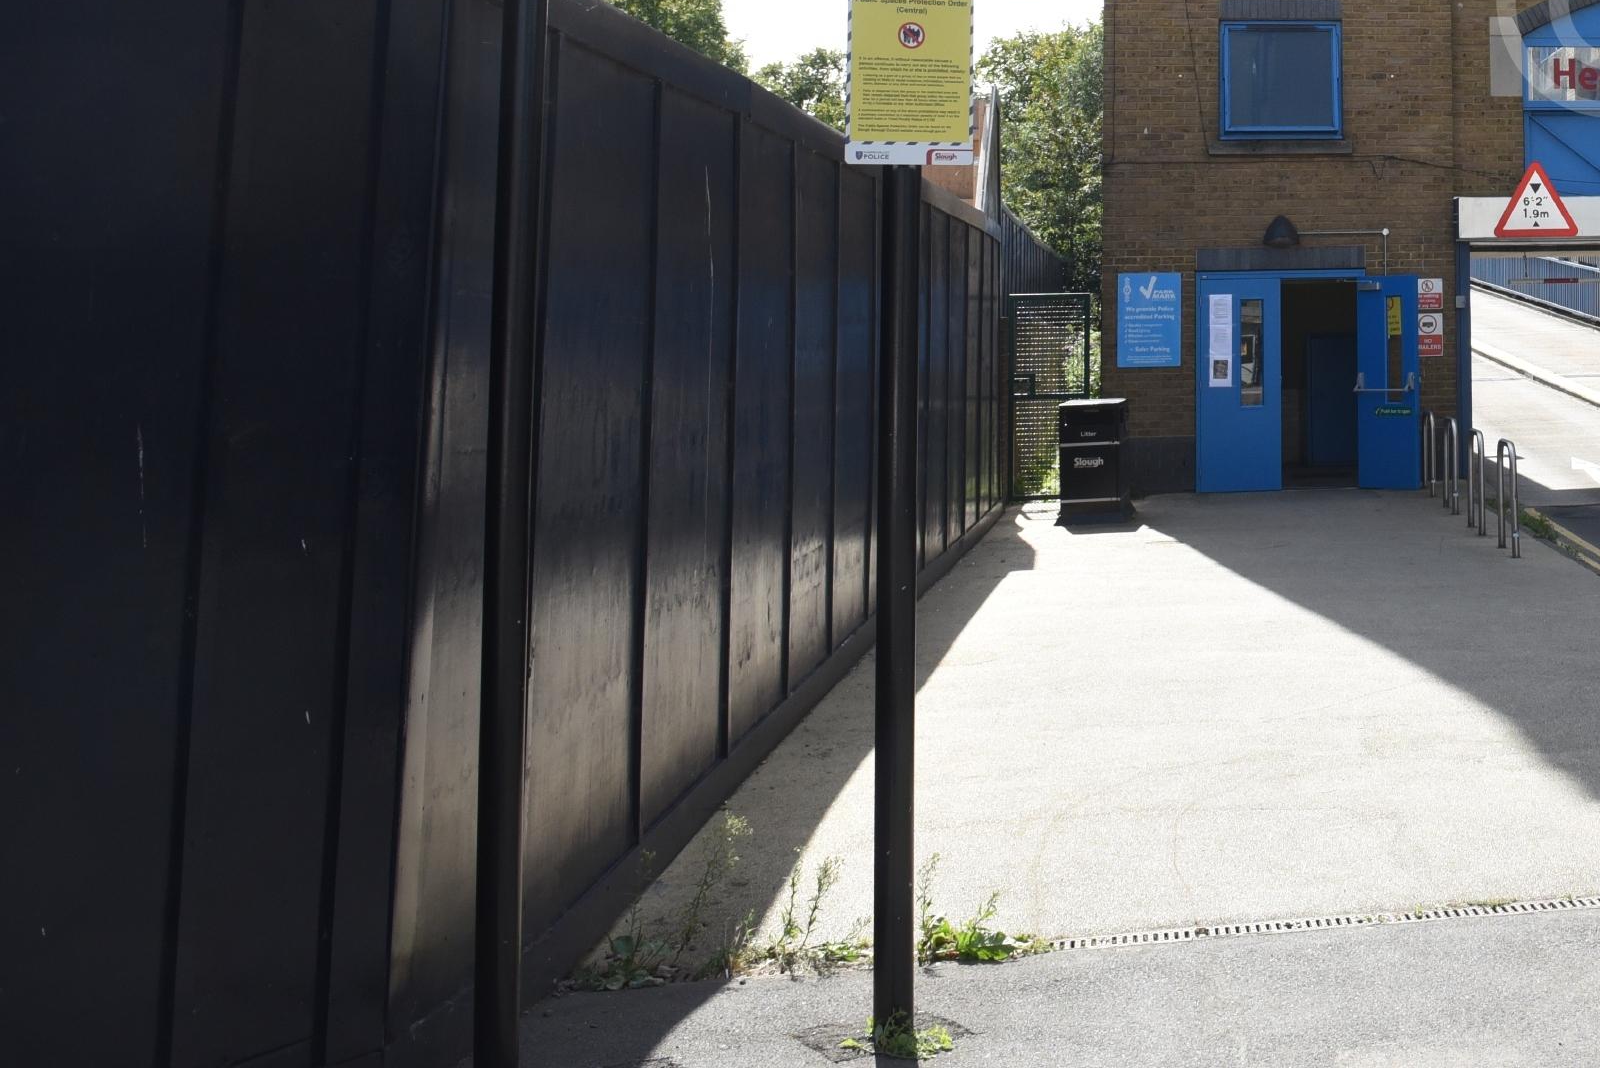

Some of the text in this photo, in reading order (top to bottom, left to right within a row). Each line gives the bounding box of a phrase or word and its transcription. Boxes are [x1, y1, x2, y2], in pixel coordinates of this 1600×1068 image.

[947, 0, 968, 7] Order
[896, 7, 928, 15] (Central)
[934, 152, 958, 161] Slough
[1523, 208, 1550, 219] 1.9m
[1073, 457, 1104, 468] Slough
